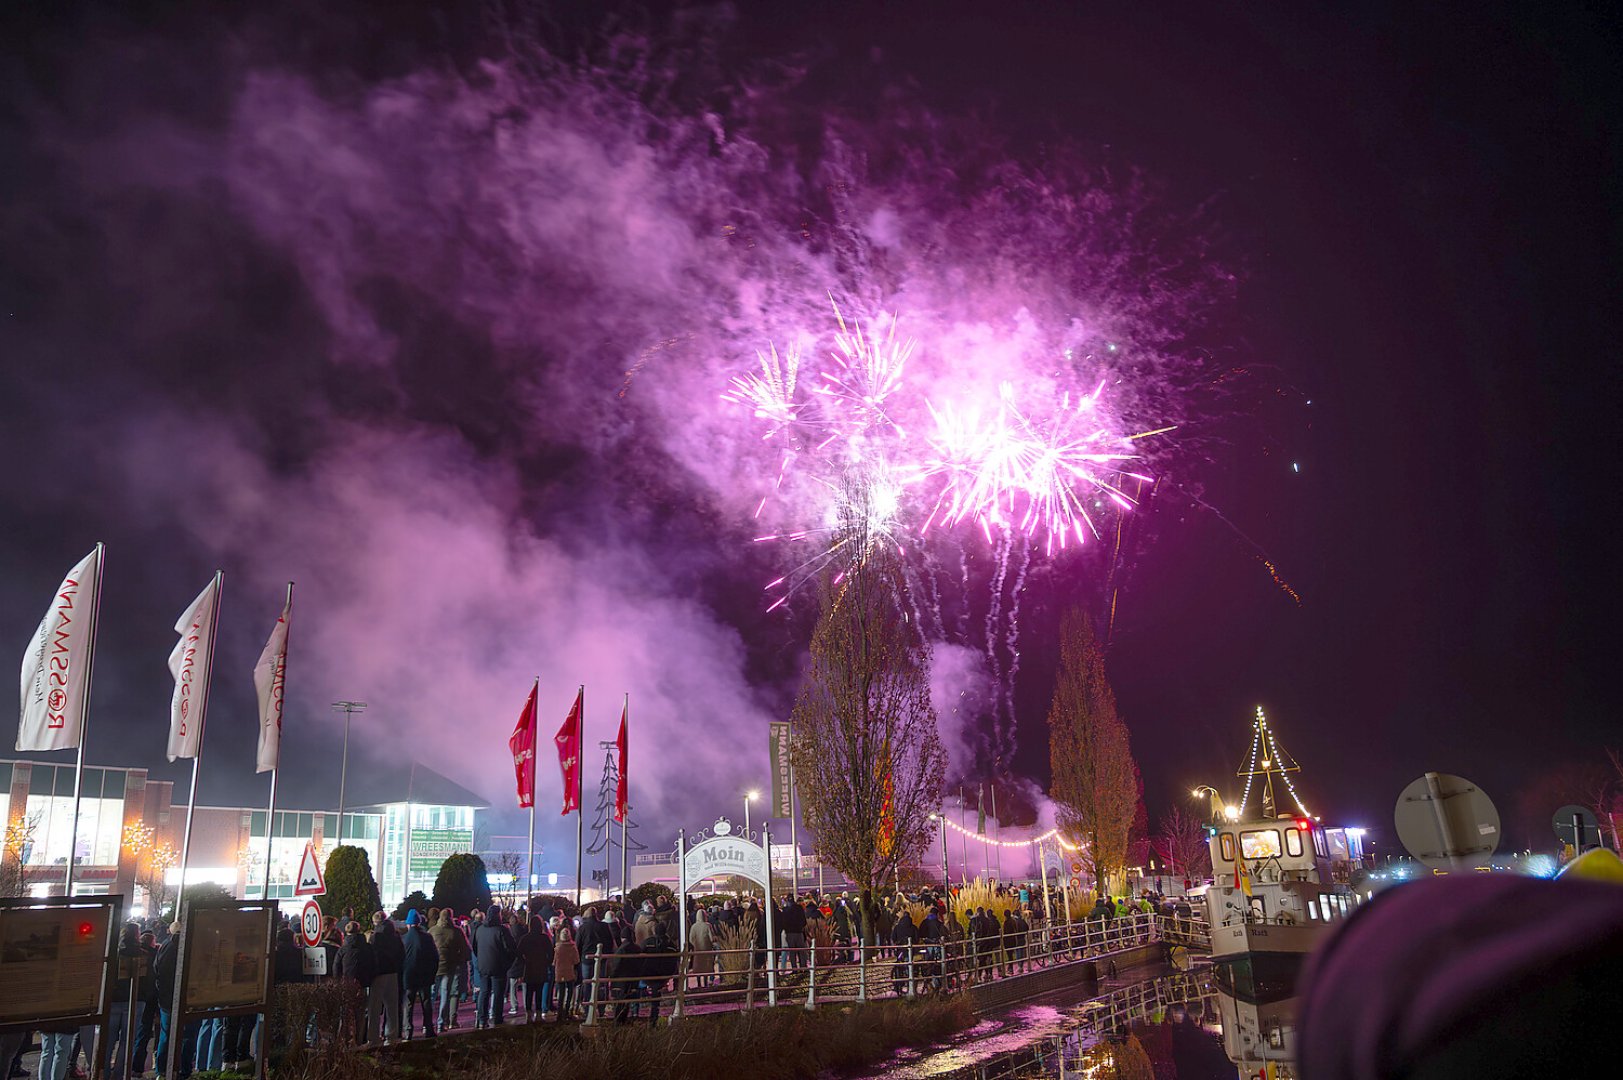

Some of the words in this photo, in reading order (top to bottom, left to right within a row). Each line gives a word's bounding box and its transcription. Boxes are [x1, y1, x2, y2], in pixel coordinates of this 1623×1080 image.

[412, 842, 470, 852] WREESMANN
[702, 846, 745, 864] Moin
[306, 913, 318, 934] 30
